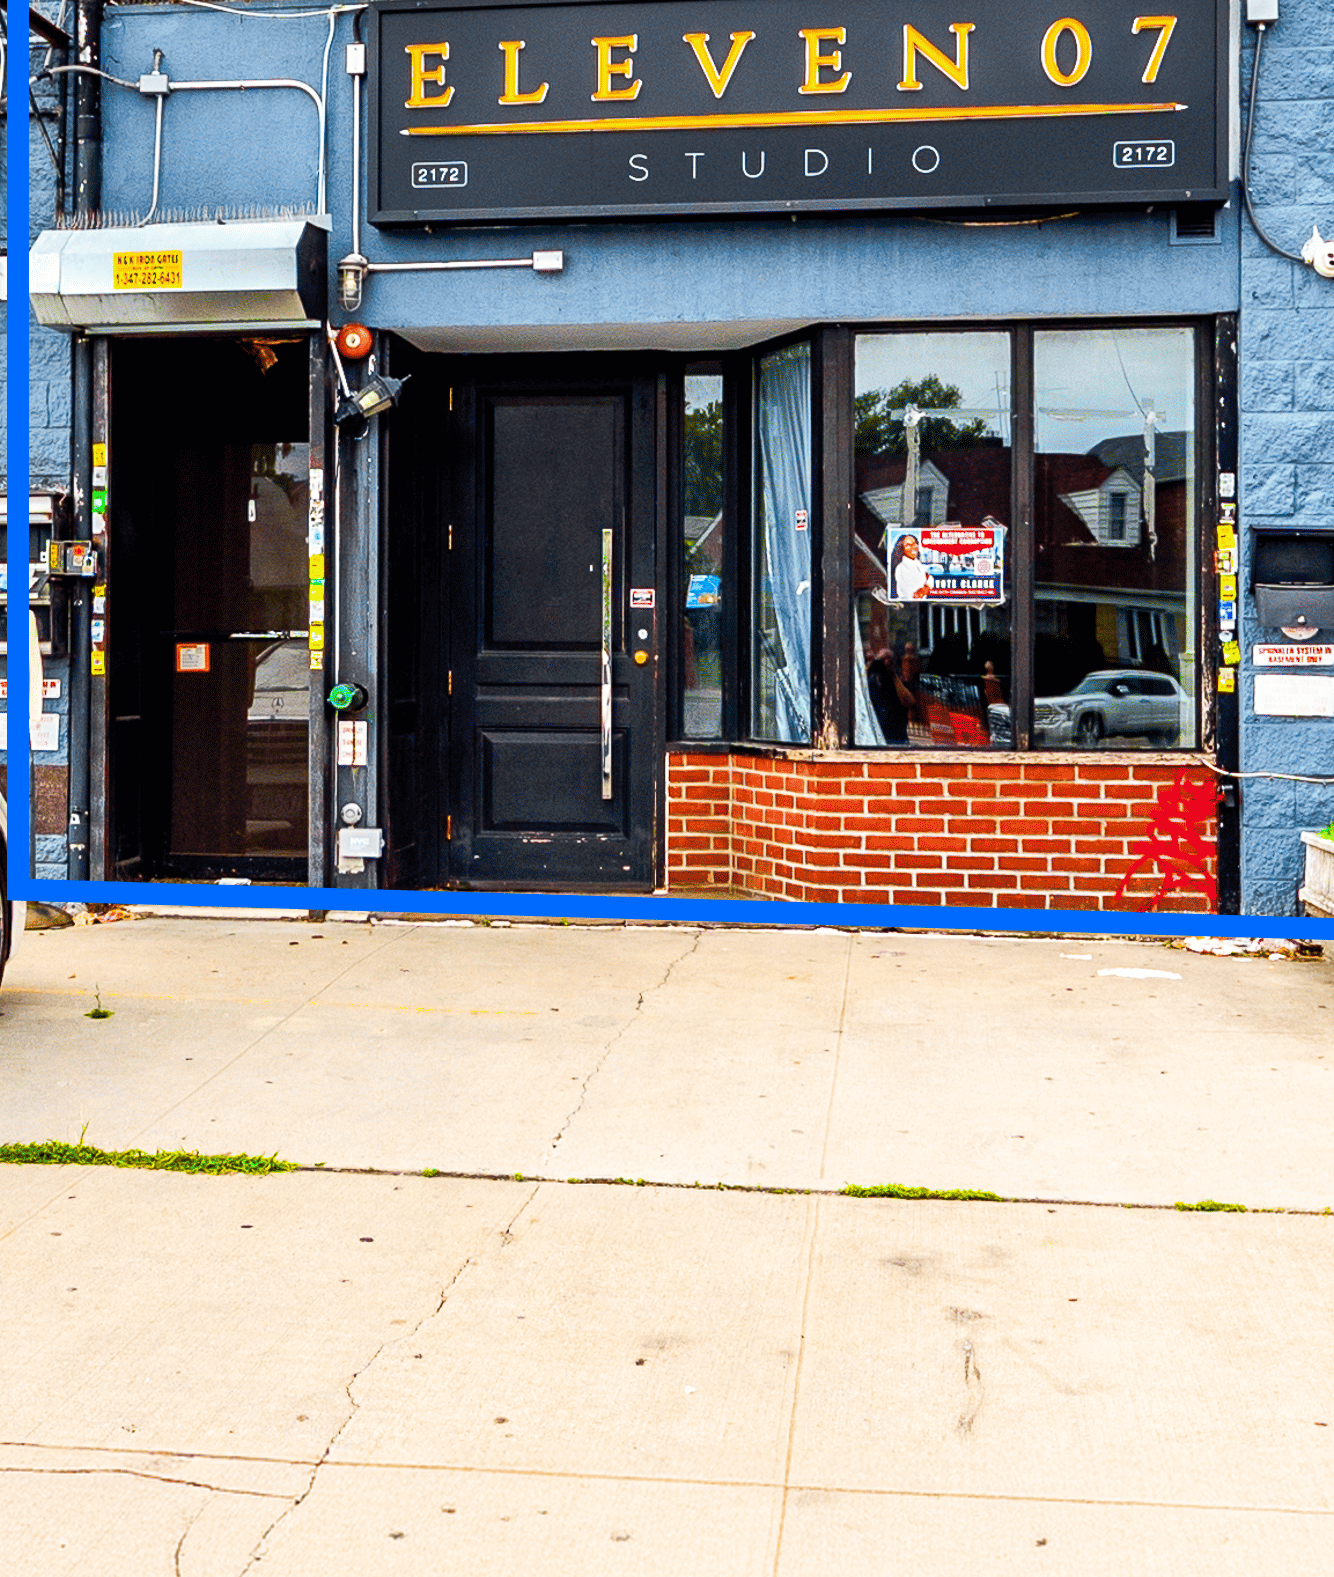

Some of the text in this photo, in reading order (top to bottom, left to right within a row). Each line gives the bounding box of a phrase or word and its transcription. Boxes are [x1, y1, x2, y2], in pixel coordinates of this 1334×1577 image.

[403, 14, 1179, 110] ELEVEN 07
[628, 144, 942, 183] STUDIO
[1121, 143, 1170, 164] 2172
[417, 165, 460, 184] 2172
